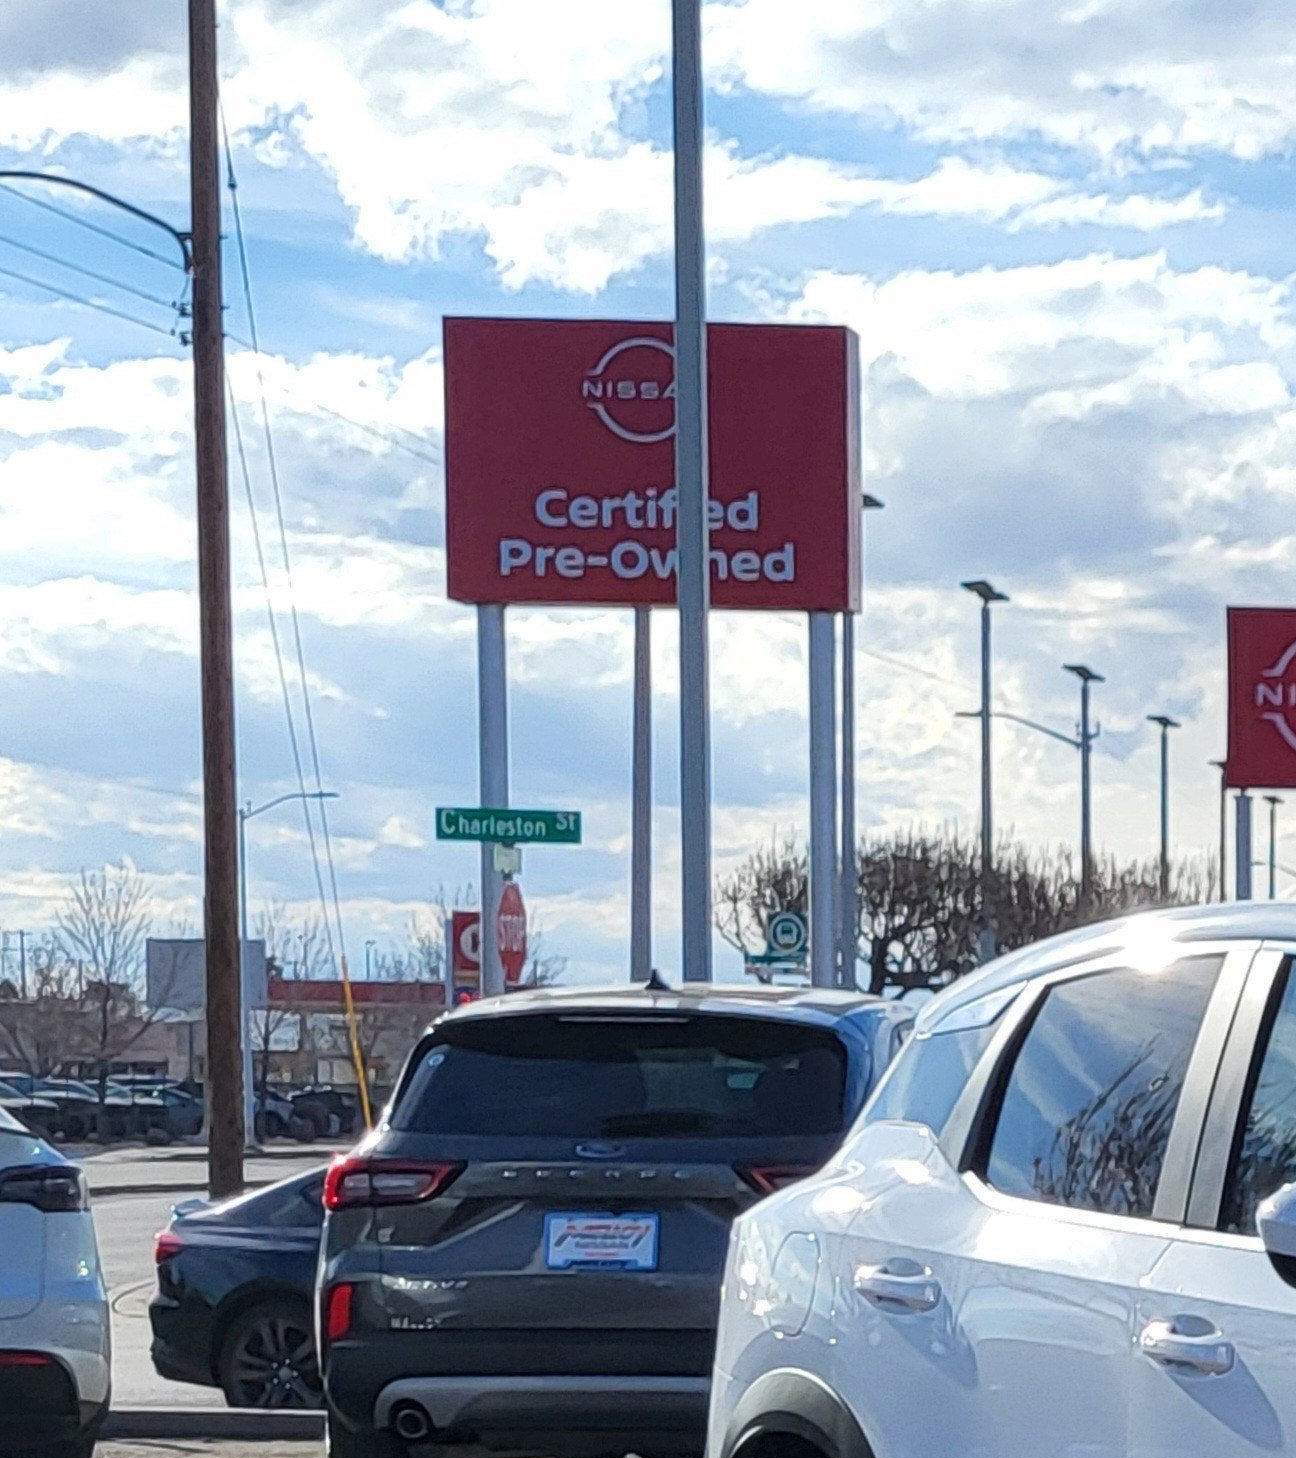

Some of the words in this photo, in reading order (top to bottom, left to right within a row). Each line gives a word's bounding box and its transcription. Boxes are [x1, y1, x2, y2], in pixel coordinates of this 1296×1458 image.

[582, 379, 677, 399] NISSA
[535, 487, 758, 532] Certifed
[441, 809, 546, 837] Charleston
[556, 812, 576, 831] St
